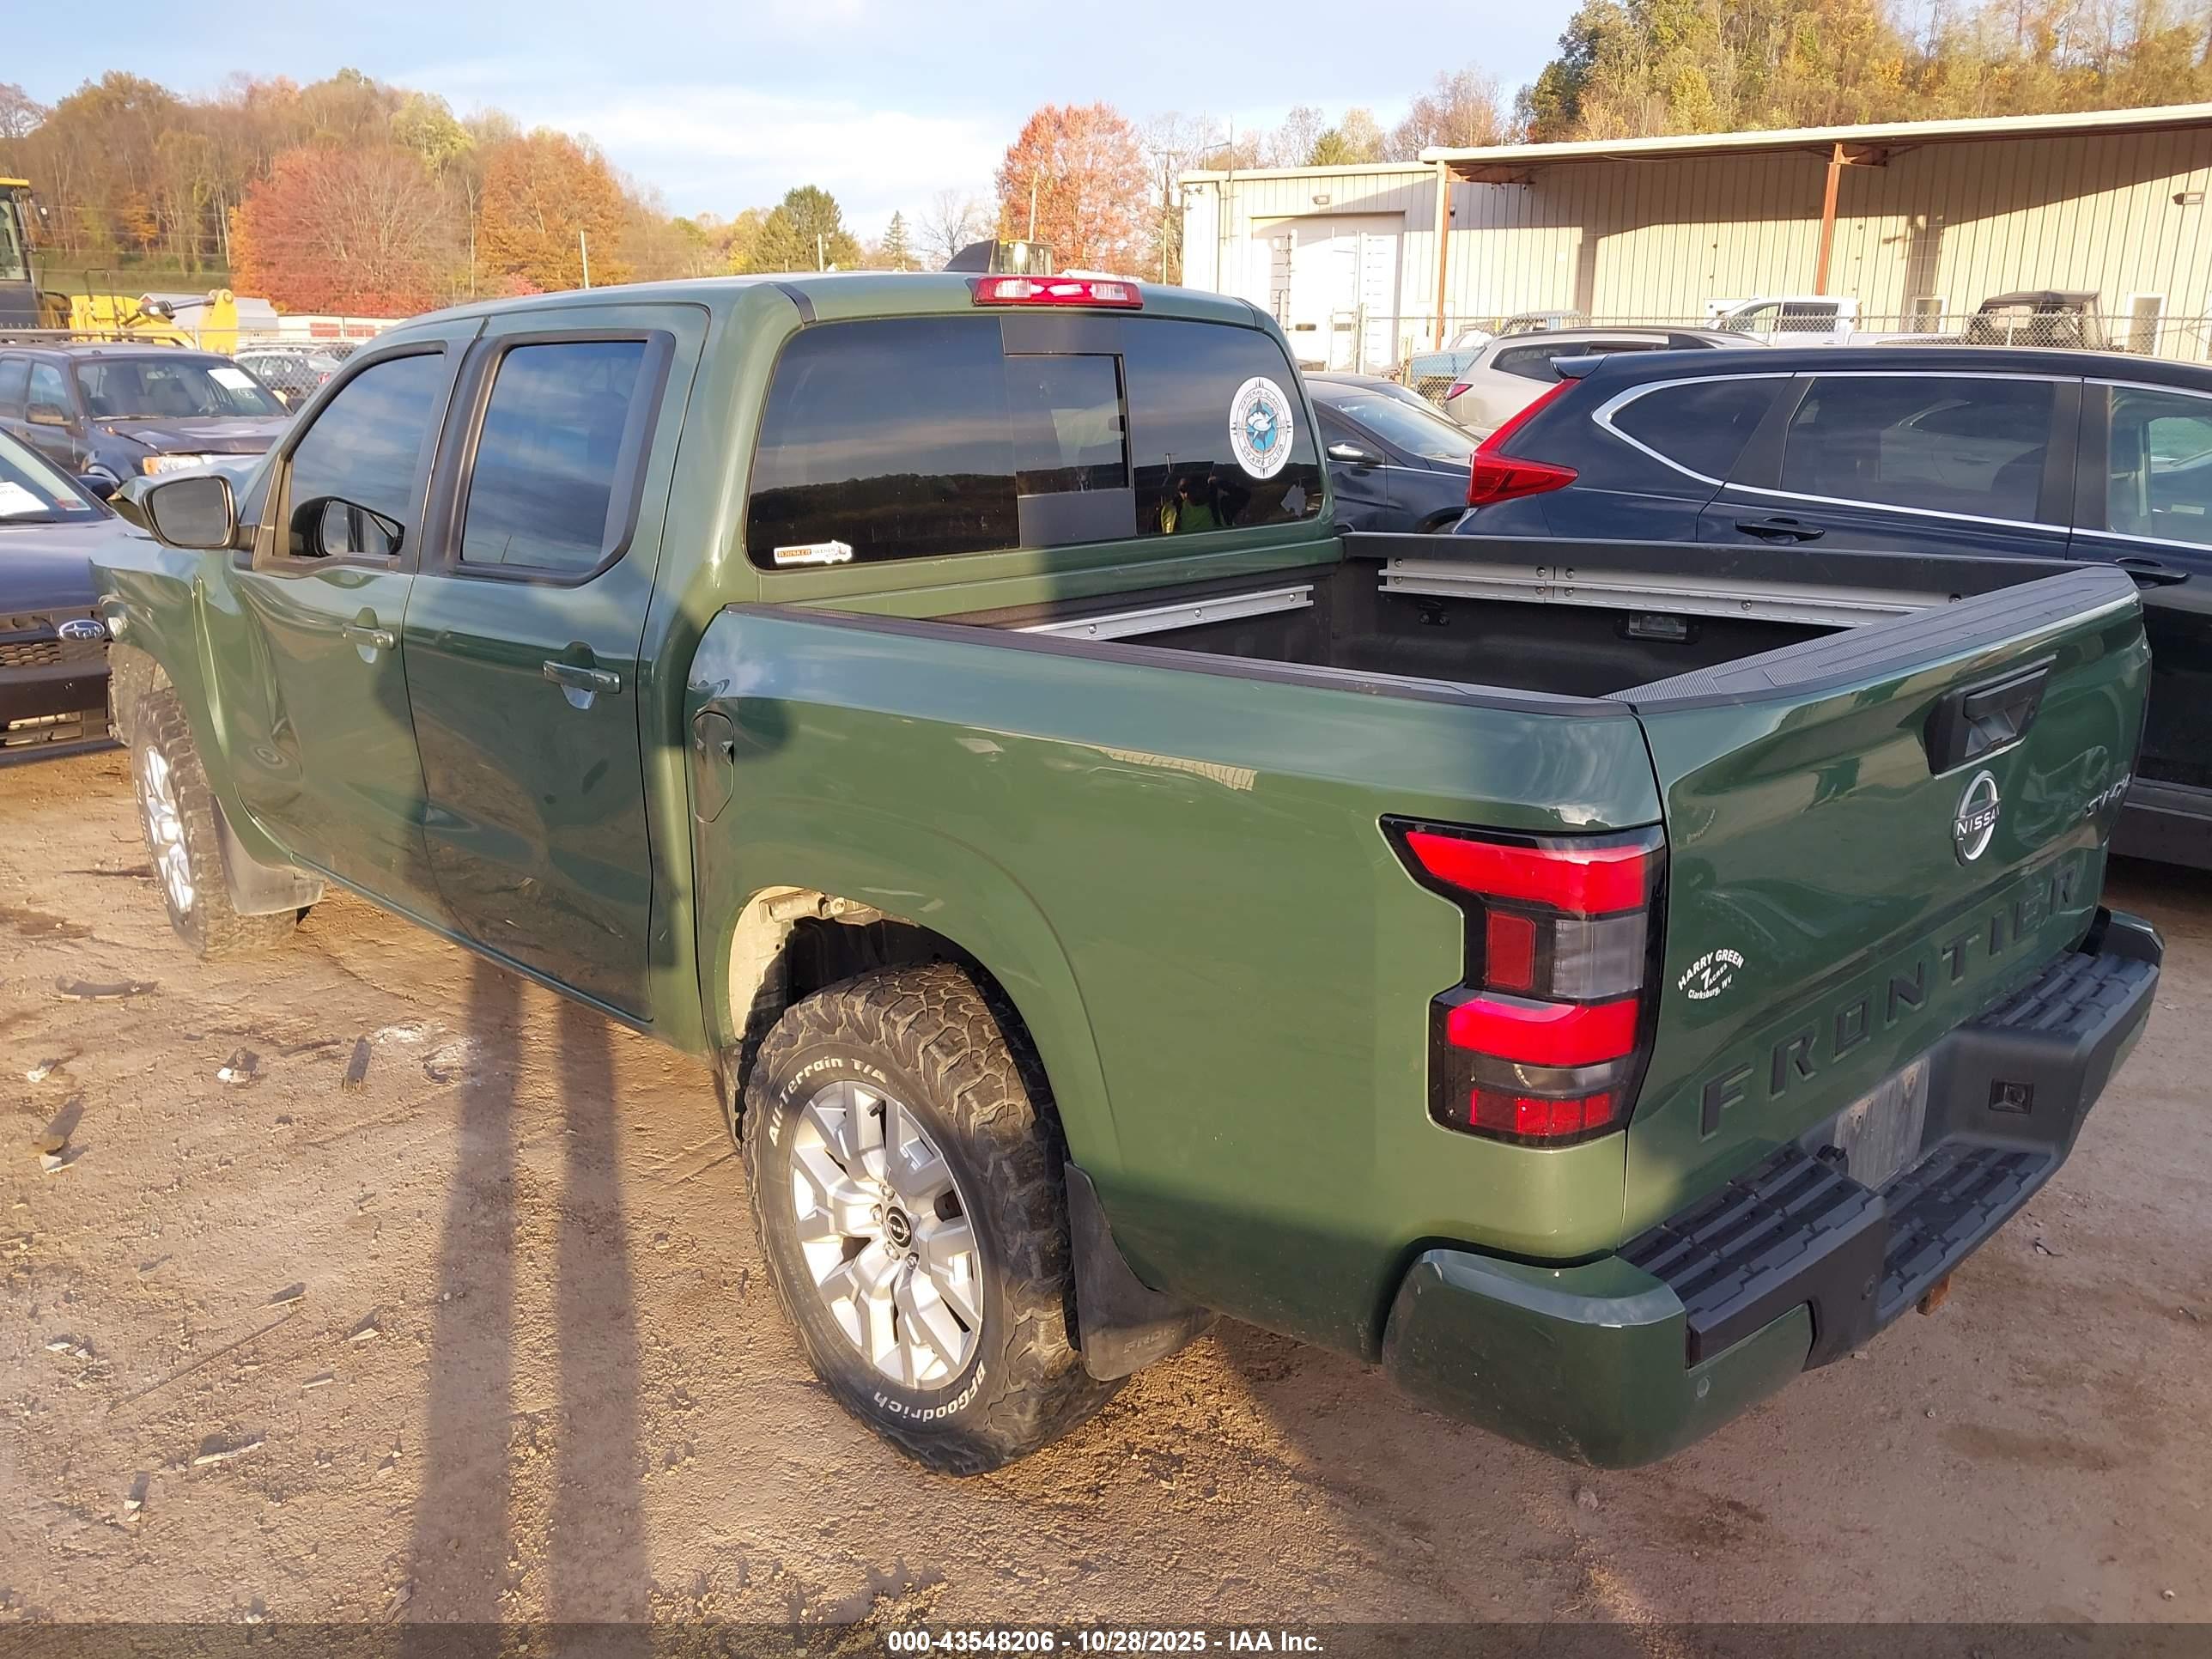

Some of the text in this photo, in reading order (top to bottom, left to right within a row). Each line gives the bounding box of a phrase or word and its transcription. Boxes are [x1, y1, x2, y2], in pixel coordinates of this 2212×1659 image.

[1242, 446, 1265, 466] SHARK
[1957, 805, 2000, 836] NISSAN
[1678, 949, 1745, 991] HARRY GREEN
[1688, 973, 1732, 1000] Clarksburg, WV
[1700, 967, 1711, 990] 7
[1699, 861, 2079, 1141] FRONTIER
[769, 1055, 844, 1147] All-Terrain
[850, 1057, 887, 1085] T/A
[873, 1359, 988, 1423] BFGoodrich
